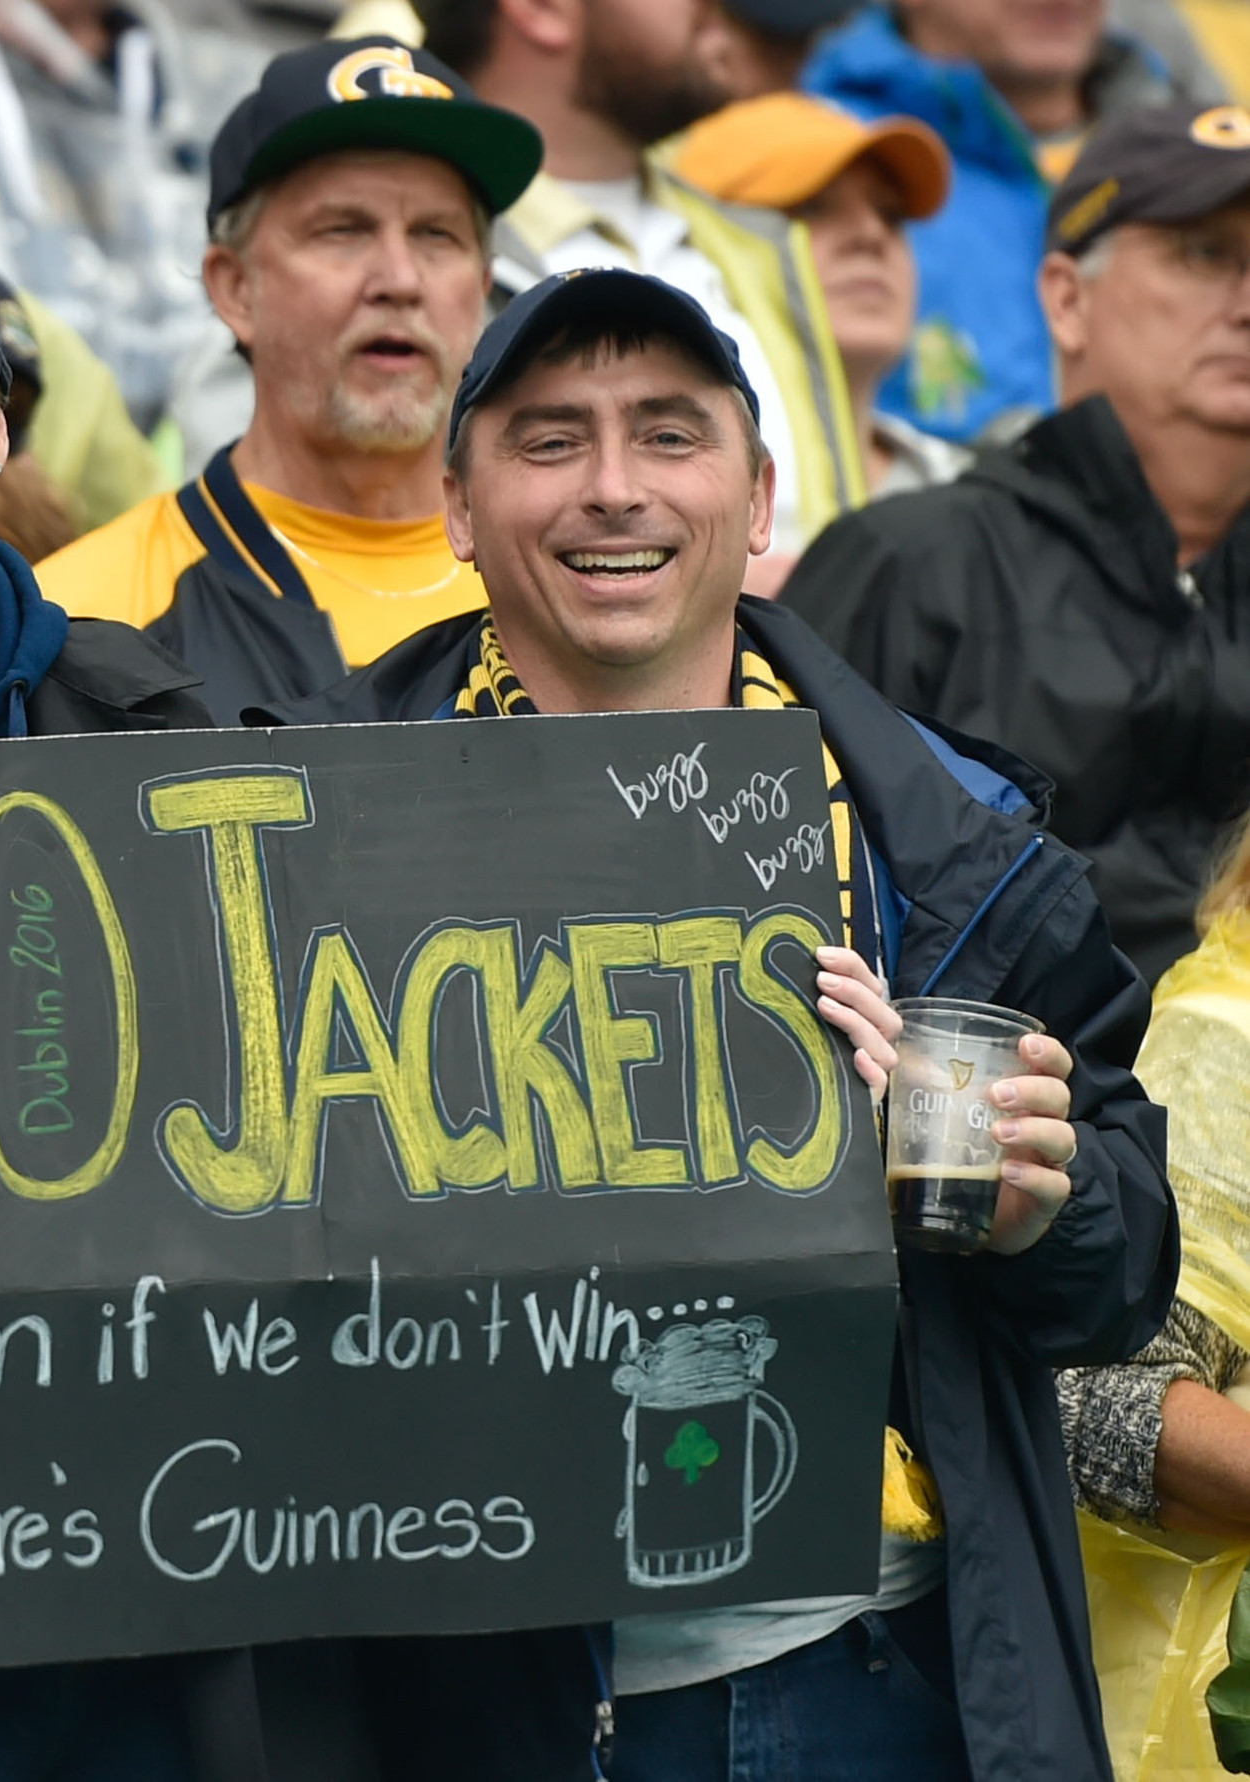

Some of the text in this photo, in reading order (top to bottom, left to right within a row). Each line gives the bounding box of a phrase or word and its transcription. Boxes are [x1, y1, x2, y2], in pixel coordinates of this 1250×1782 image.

[606, 742, 709, 820] buzz
[697, 766, 802, 844] buzz
[743, 818, 831, 892] buzz
[9, 883, 75, 1135] Dublin 2016
[97, 1274, 167, 1385] if
[331, 1256, 510, 1368] don't
[139, 1437, 536, 1581] Guinness
